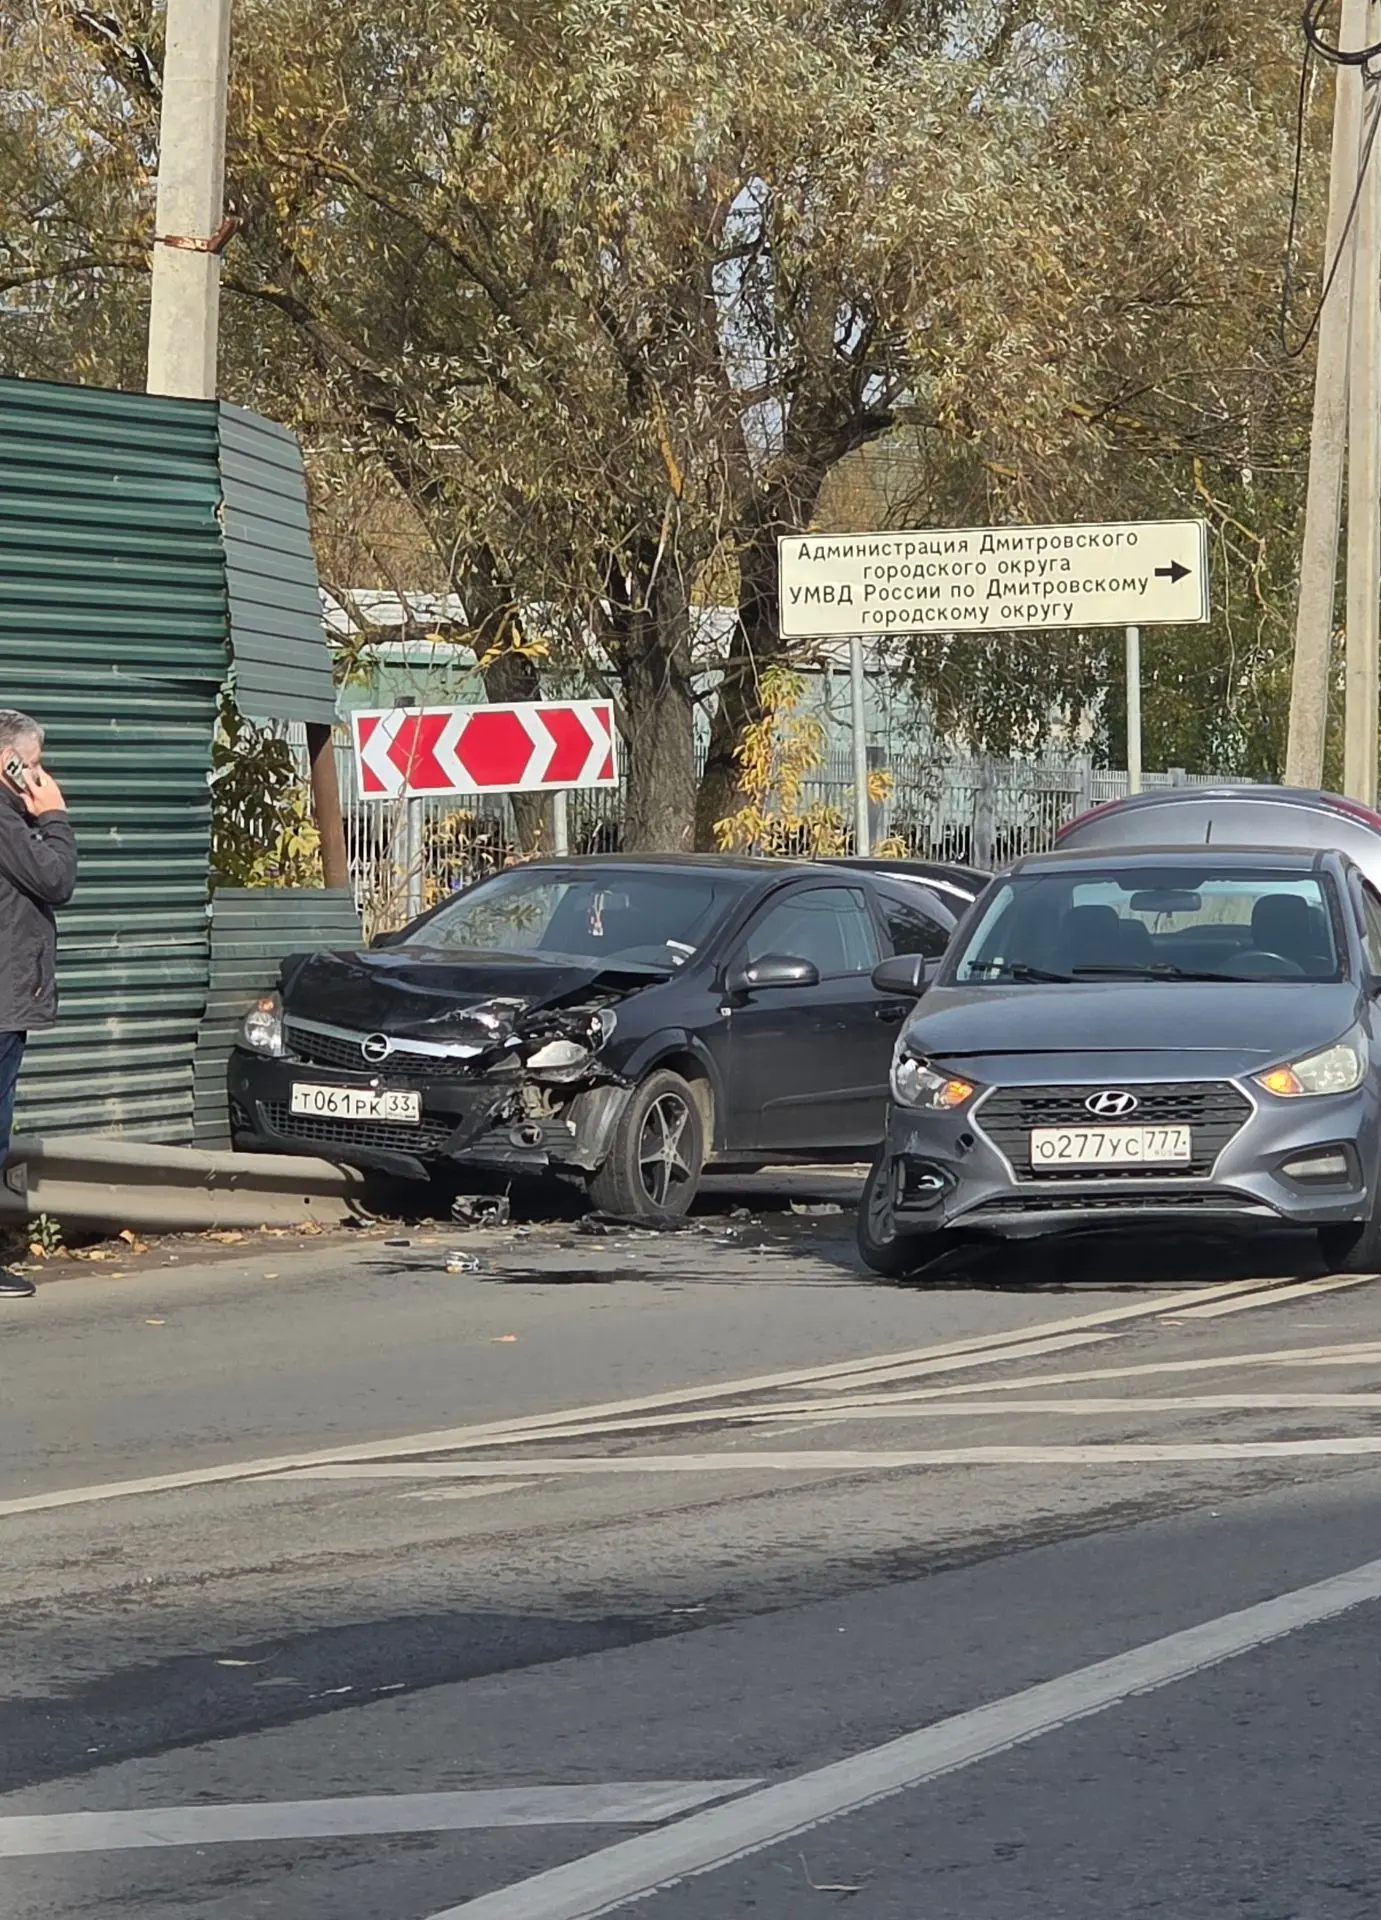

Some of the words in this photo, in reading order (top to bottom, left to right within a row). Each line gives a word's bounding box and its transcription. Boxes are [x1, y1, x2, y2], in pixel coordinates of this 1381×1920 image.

[798, 541, 968, 561] Администрация
[979, 533, 1138, 555] Дмитровского
[863, 562, 987, 583] городского
[998, 558, 1071, 577] округа
[789, 585, 853, 606] УМВД
[864, 584, 941, 602] России
[951, 585, 975, 598] по
[986, 577, 1148, 600] Дмитровскому
[862, 606, 989, 628] городскому
[1000, 602, 1073, 622] округу
[388, 1095, 410, 1112] 33
[1144, 1130, 1182, 1149] 777
